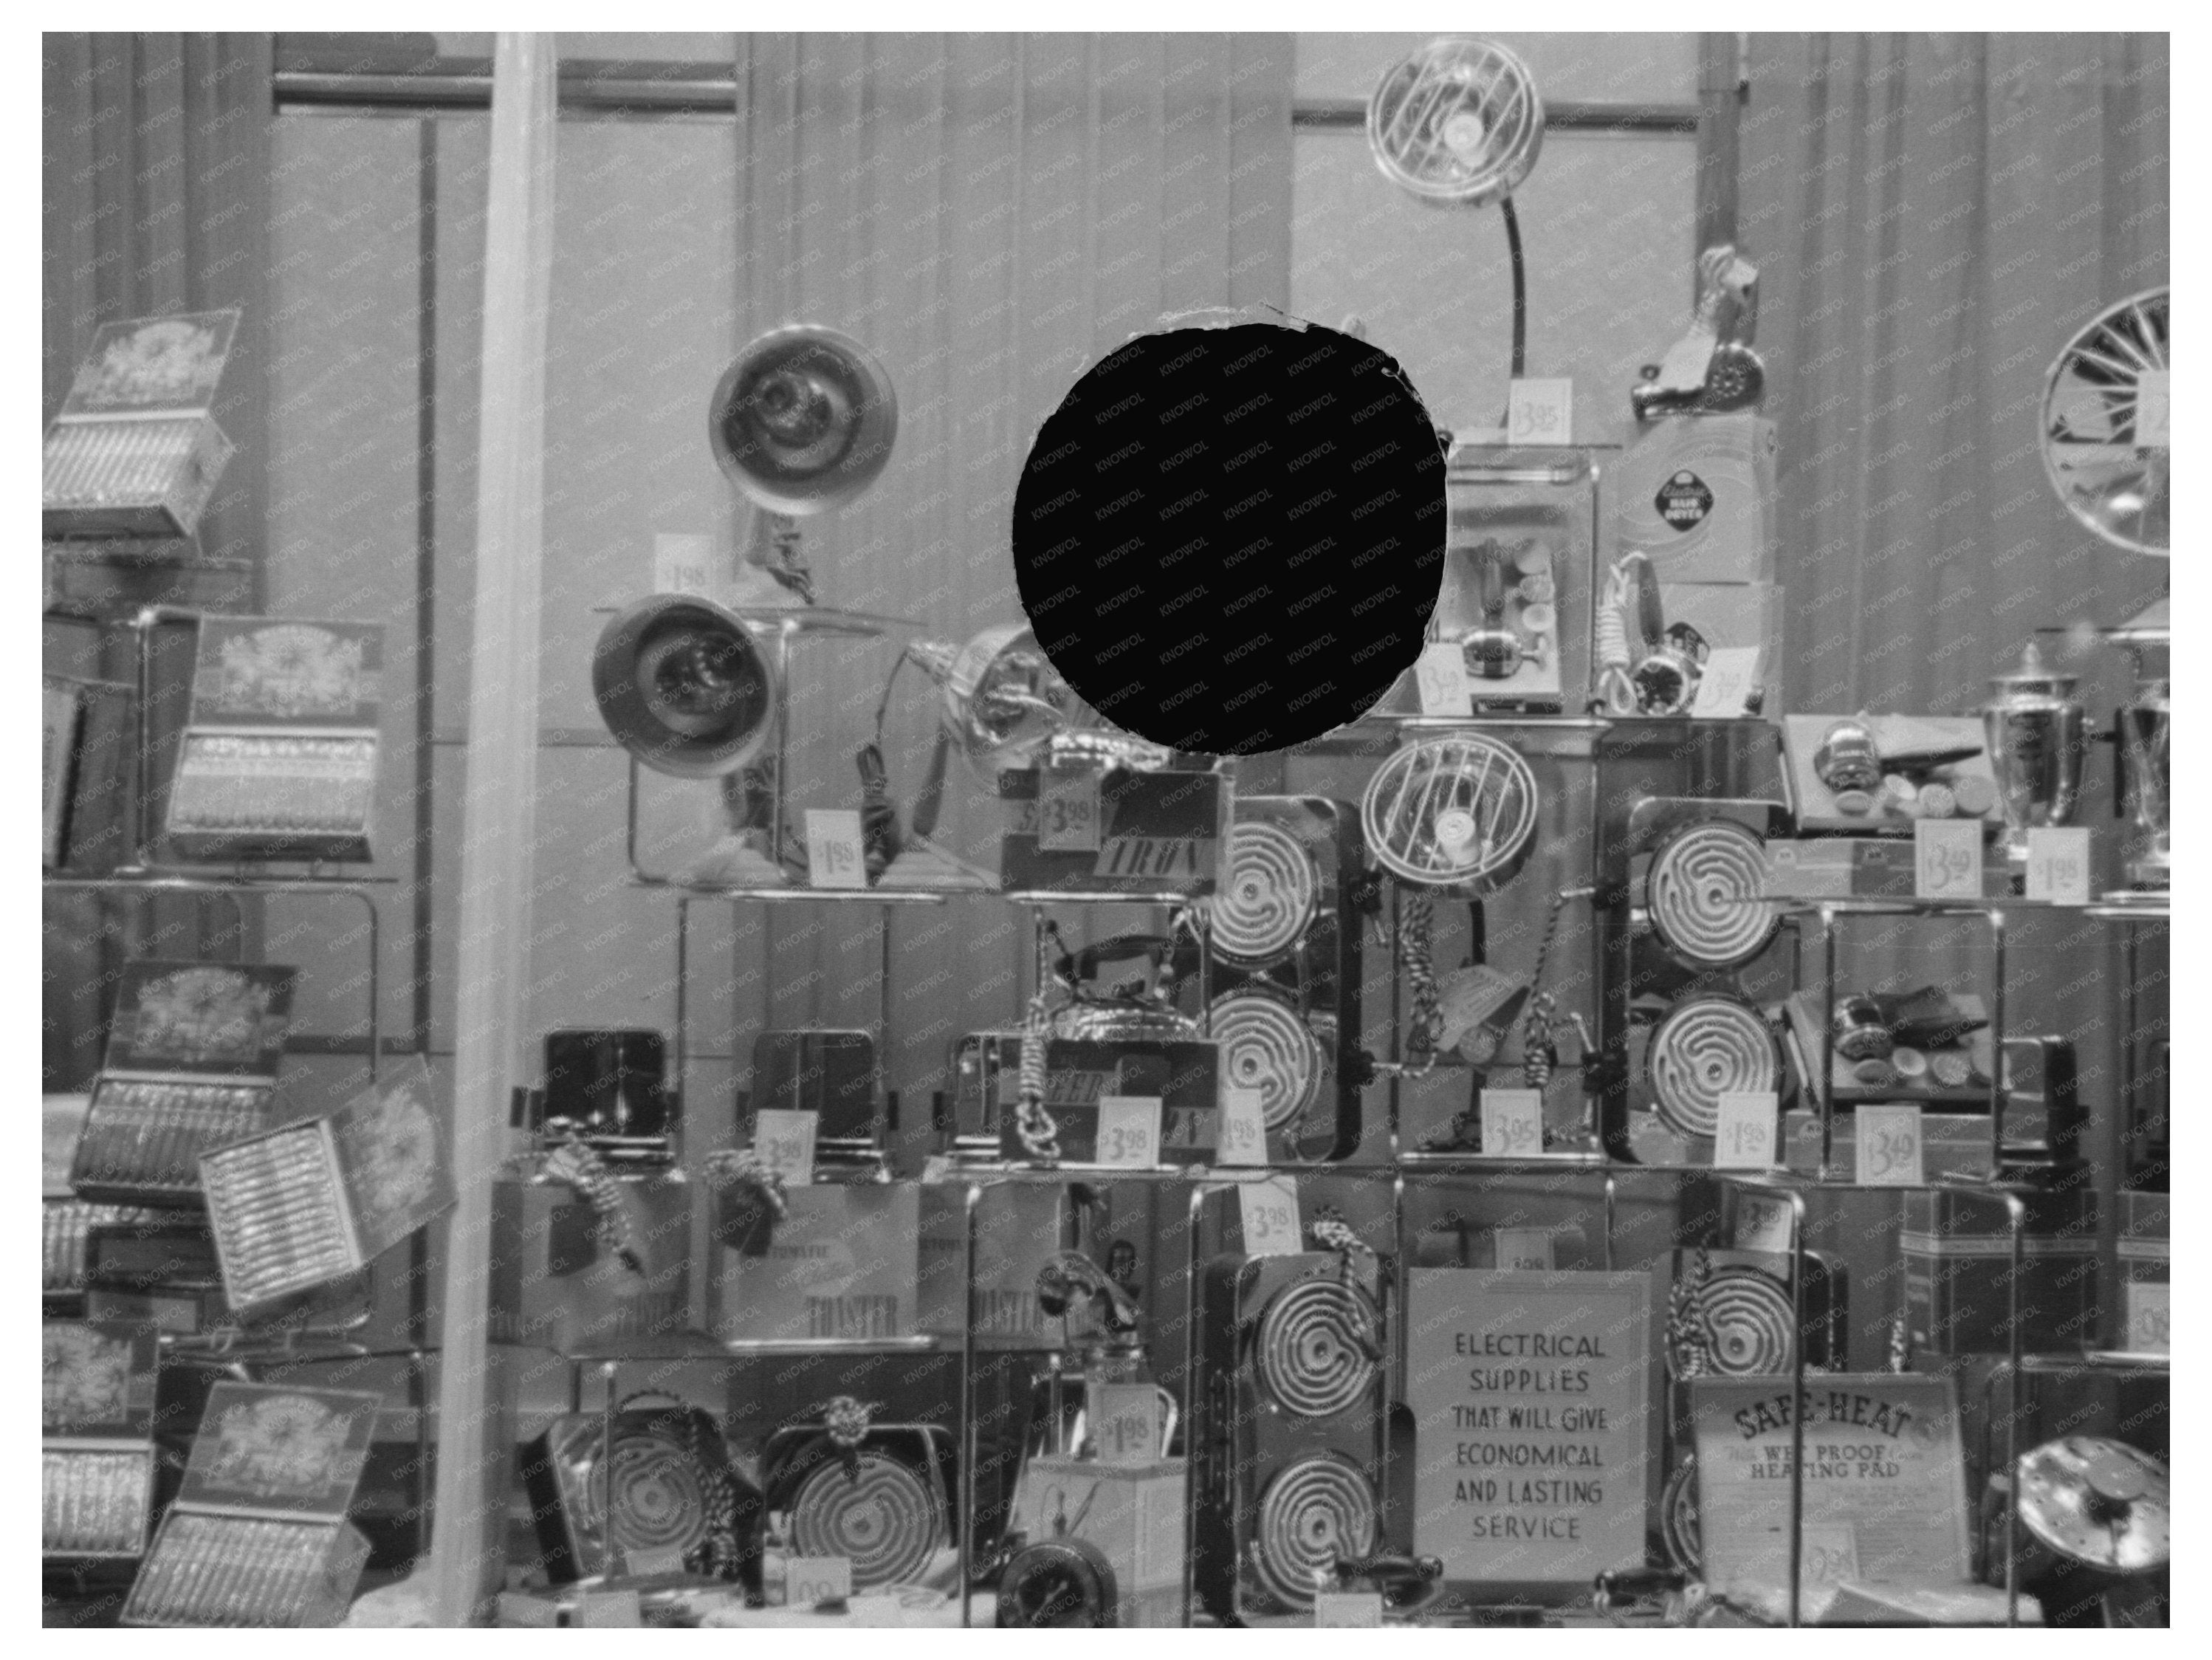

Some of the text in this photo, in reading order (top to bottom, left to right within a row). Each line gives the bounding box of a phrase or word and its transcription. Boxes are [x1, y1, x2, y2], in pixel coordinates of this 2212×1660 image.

[1455, 1333, 1606, 1357] ELECTRICAL
[1470, 1369, 1589, 1392] SUPPLIES
[1454, 1406, 1608, 1432] THAT WILL GIVE
[1457, 1443, 1604, 1467] ECONOMICAL
[1816, 1445, 1886, 1461] PROOF
[1858, 1463, 1900, 1478] PAD
[1455, 1480, 1603, 1504] AND LASTING
[1473, 1516, 1581, 1539] SERVICE
